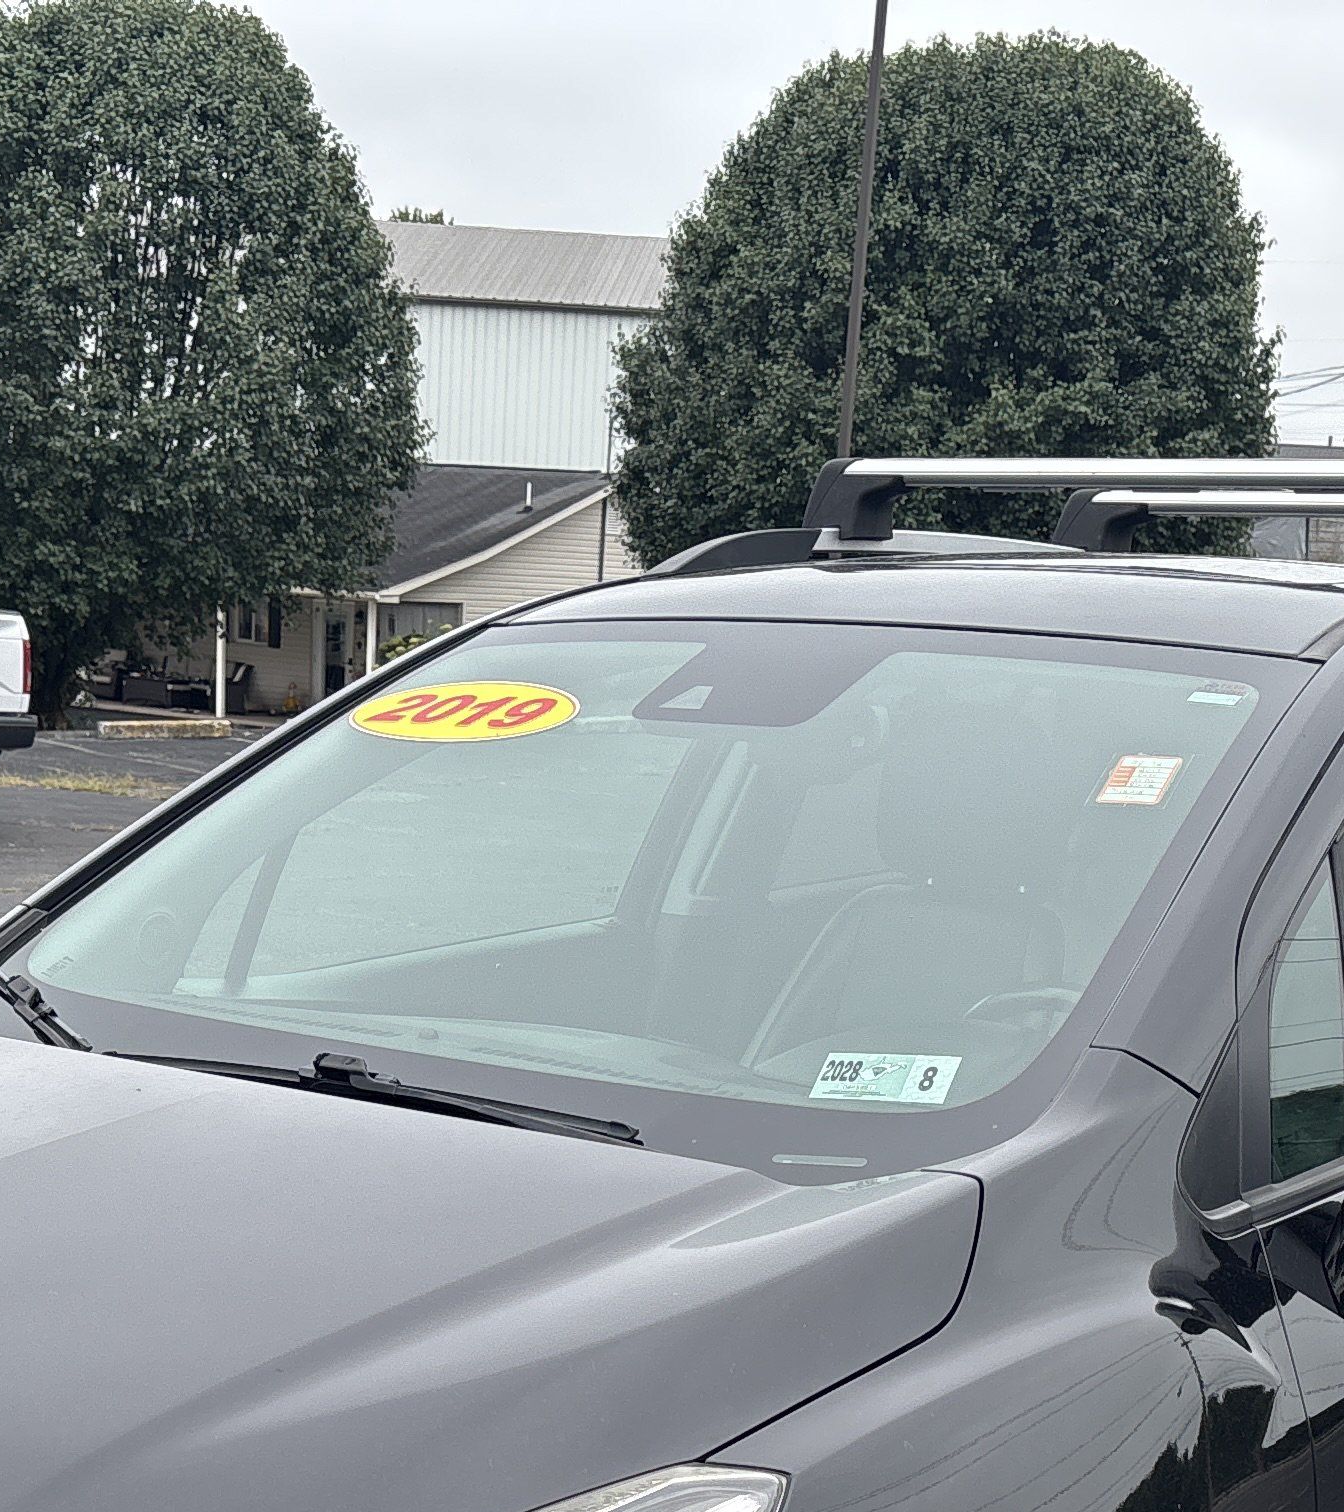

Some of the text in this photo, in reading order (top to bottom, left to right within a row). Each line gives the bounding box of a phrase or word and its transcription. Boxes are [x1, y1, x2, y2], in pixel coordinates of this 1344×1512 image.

[363, 694, 558, 728] 2019
[820, 1060, 863, 1082] 2028
[918, 1066, 939, 1091] 8
